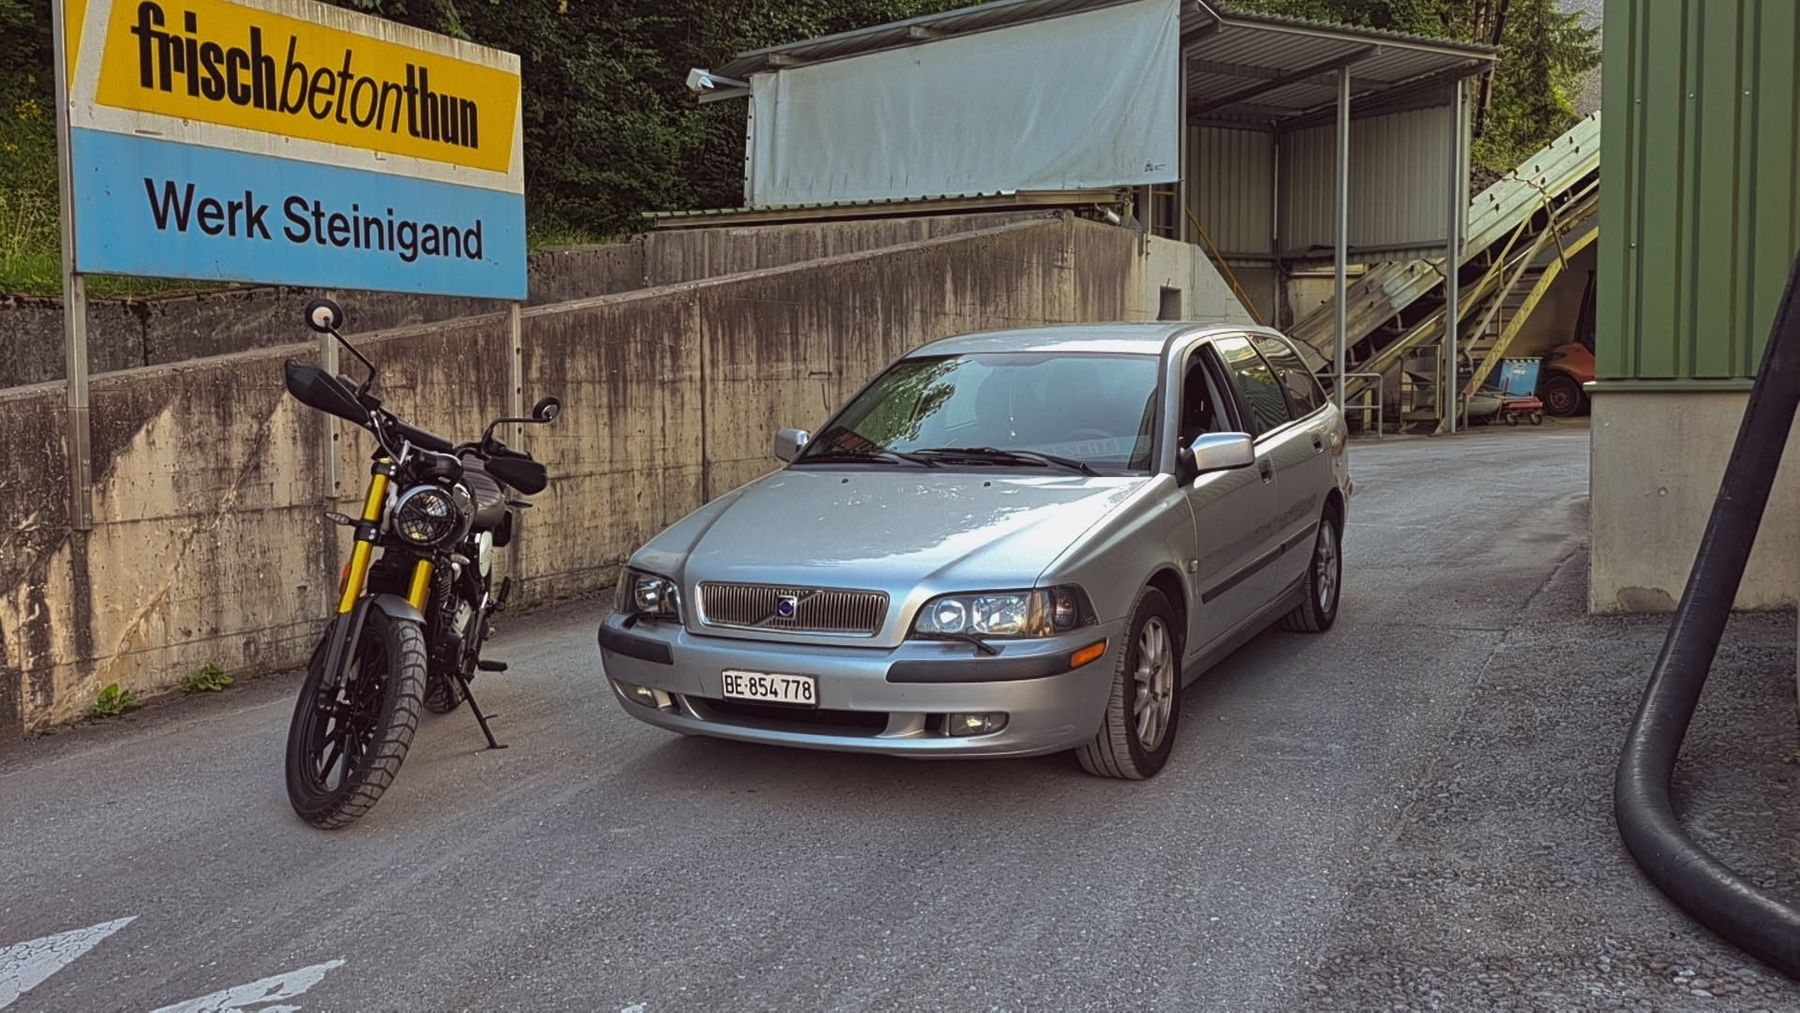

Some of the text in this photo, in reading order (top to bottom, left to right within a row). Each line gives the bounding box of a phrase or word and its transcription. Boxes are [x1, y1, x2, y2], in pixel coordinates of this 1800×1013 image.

[131, 1, 479, 149] frischbetonthun
[144, 177, 483, 262] Werk Steinigand
